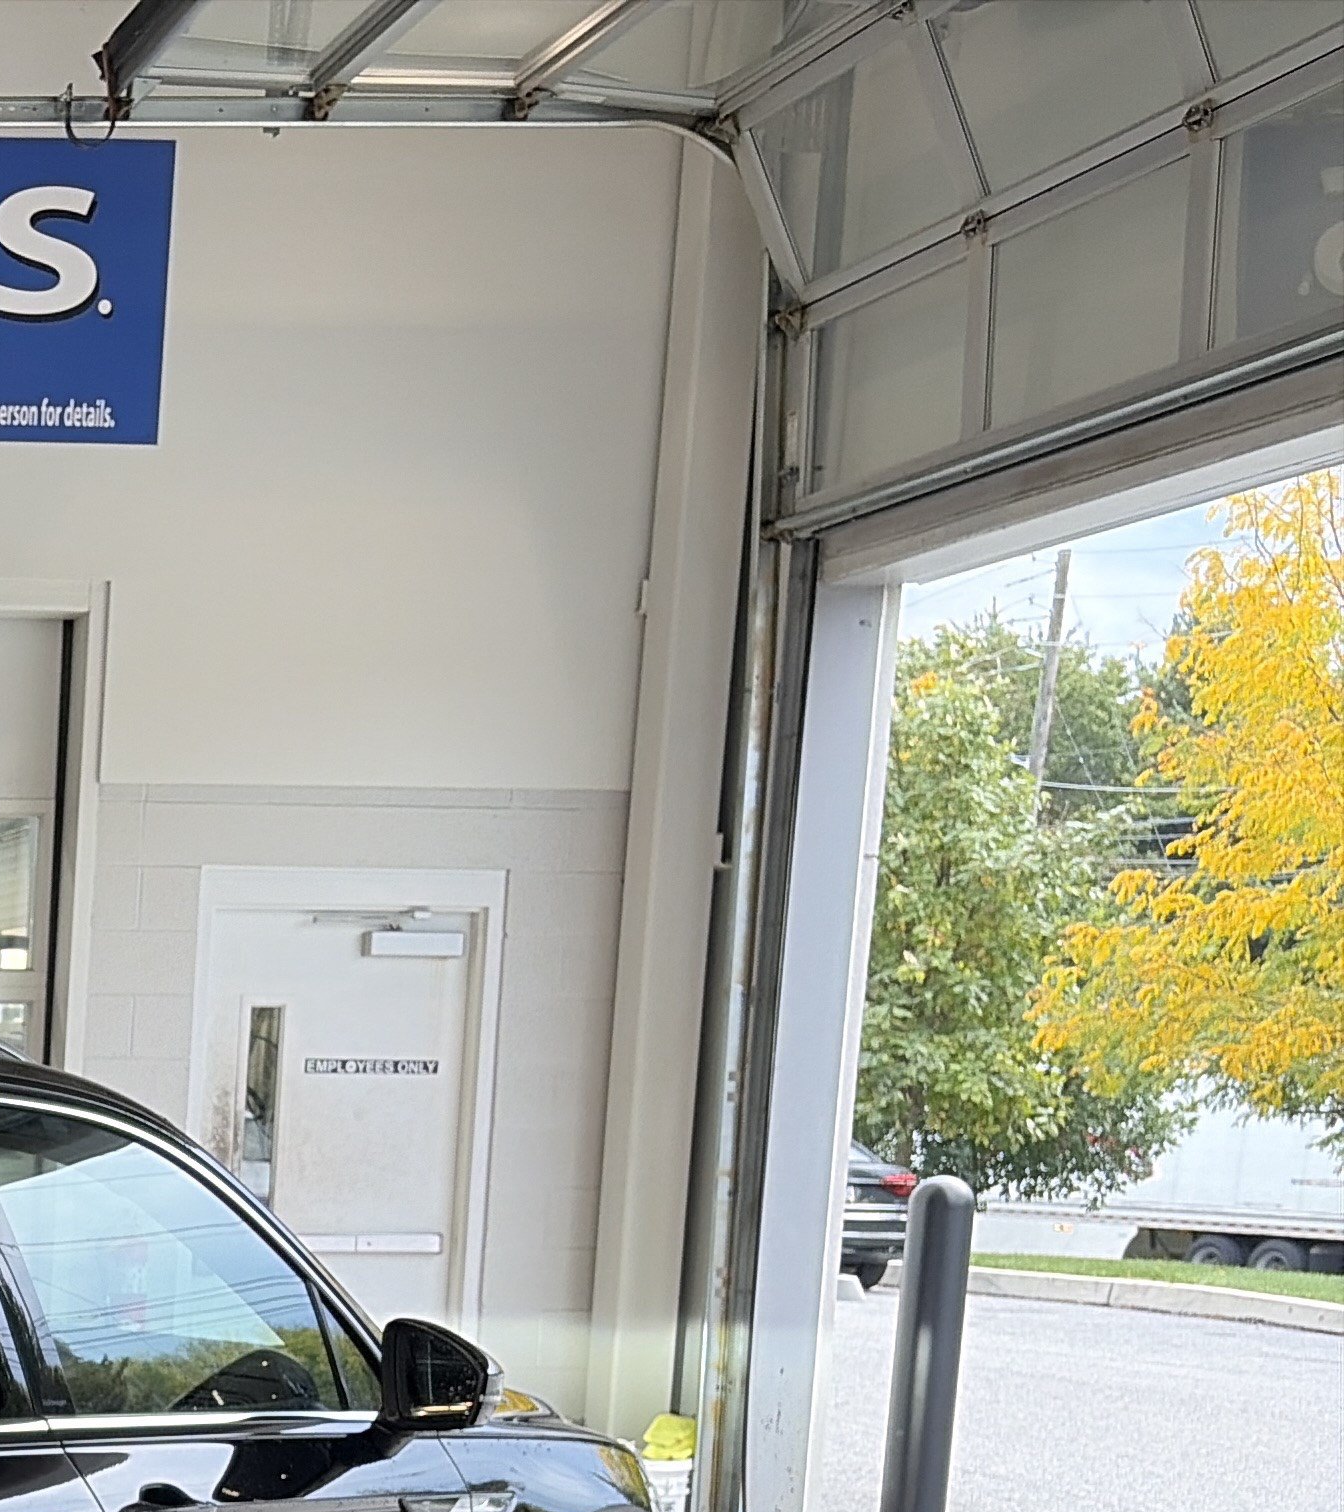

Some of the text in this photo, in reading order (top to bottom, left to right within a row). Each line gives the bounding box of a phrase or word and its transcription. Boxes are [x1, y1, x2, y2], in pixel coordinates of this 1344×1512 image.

[40, 397, 62, 427] for
[63, 398, 115, 428] details.
[305, 1059, 438, 1074] EMPLOYEES ONLY
